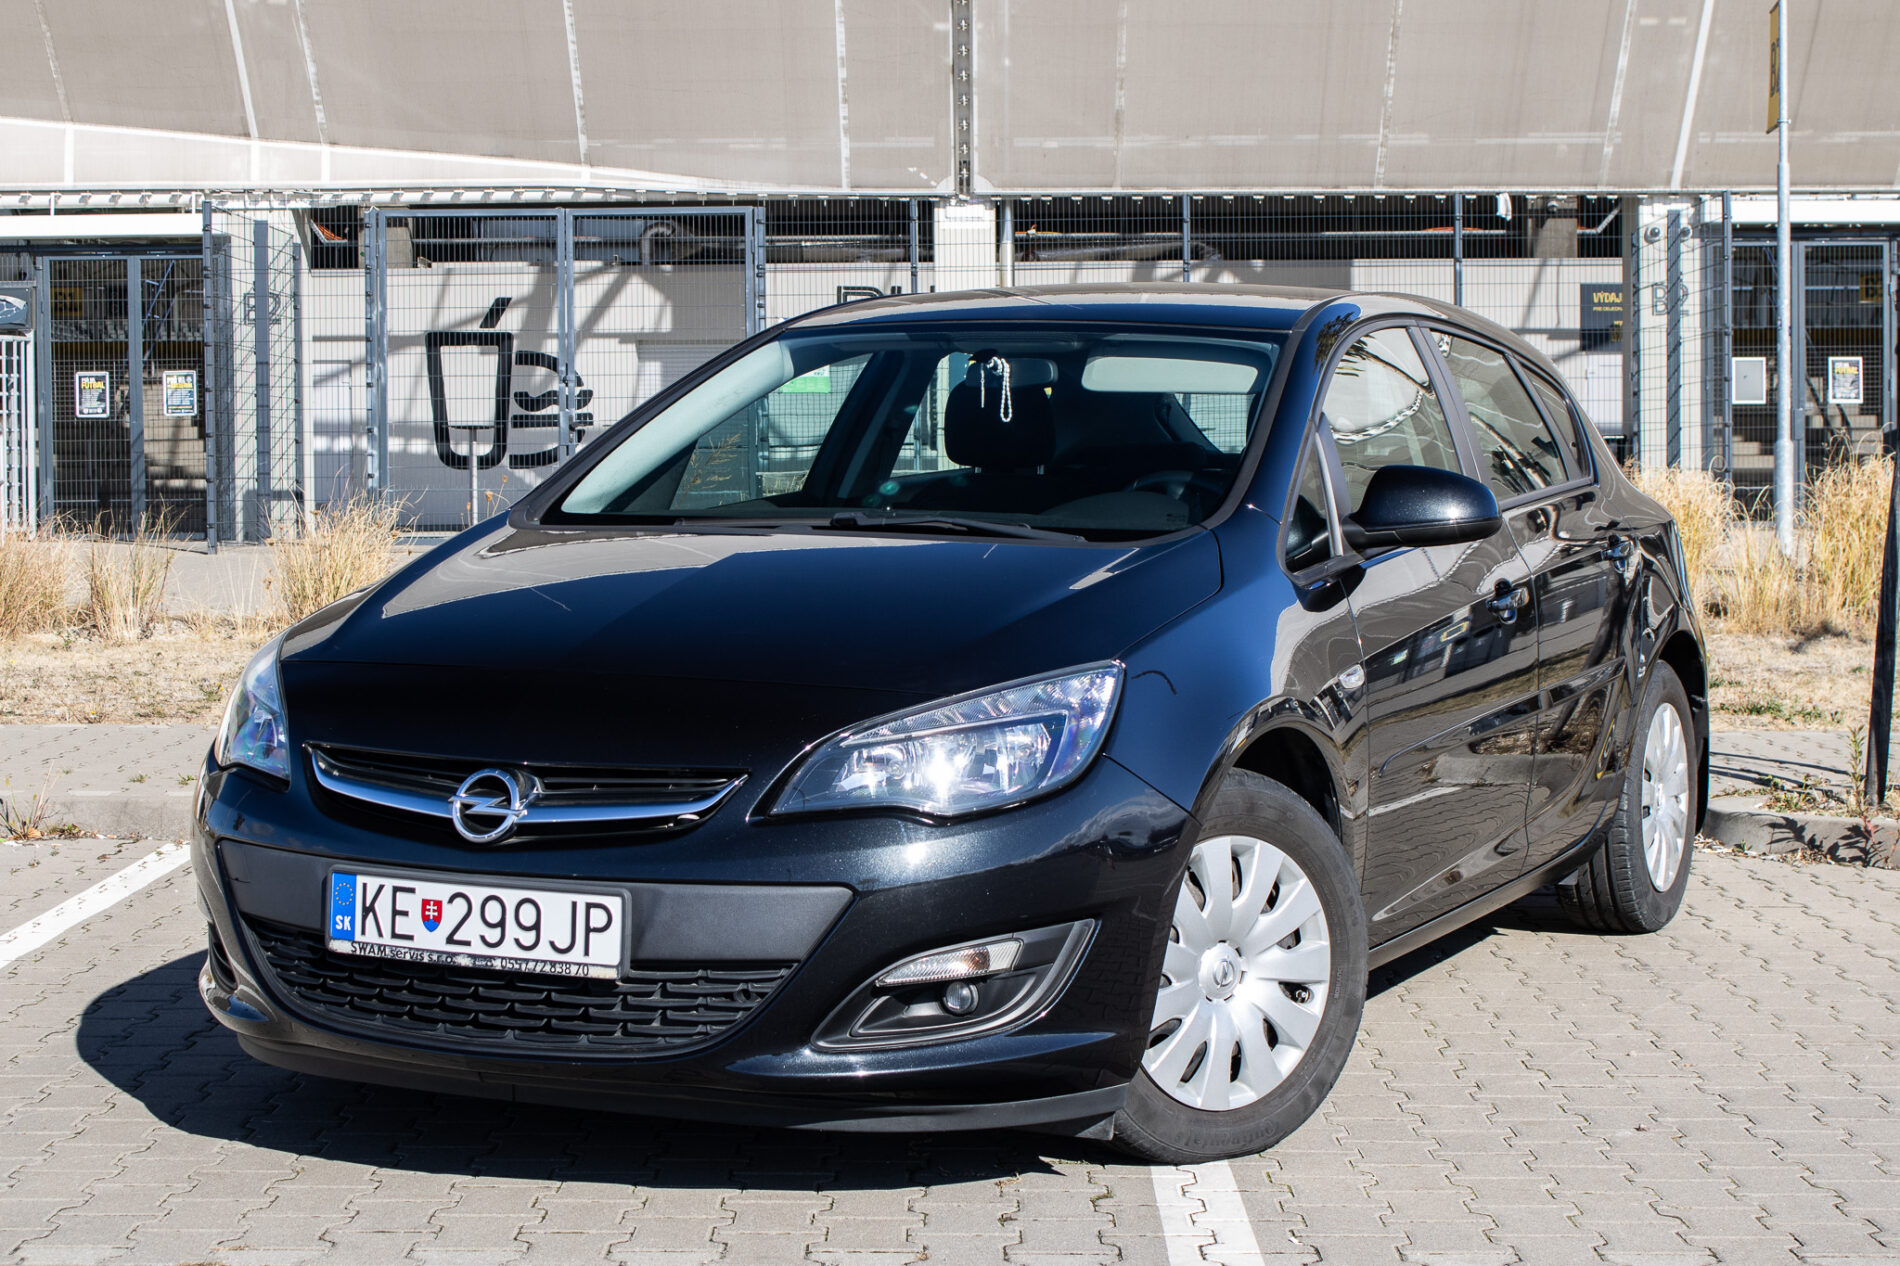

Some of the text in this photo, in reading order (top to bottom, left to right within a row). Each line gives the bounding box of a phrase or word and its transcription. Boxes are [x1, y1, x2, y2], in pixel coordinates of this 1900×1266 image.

[81, 381, 105, 389] FUTBAL
[335, 915, 352, 931] SK
[360, 882, 613, 957] KE 299JP
[351, 941, 387, 957] SWAM
[390, 949, 425, 962] servis
